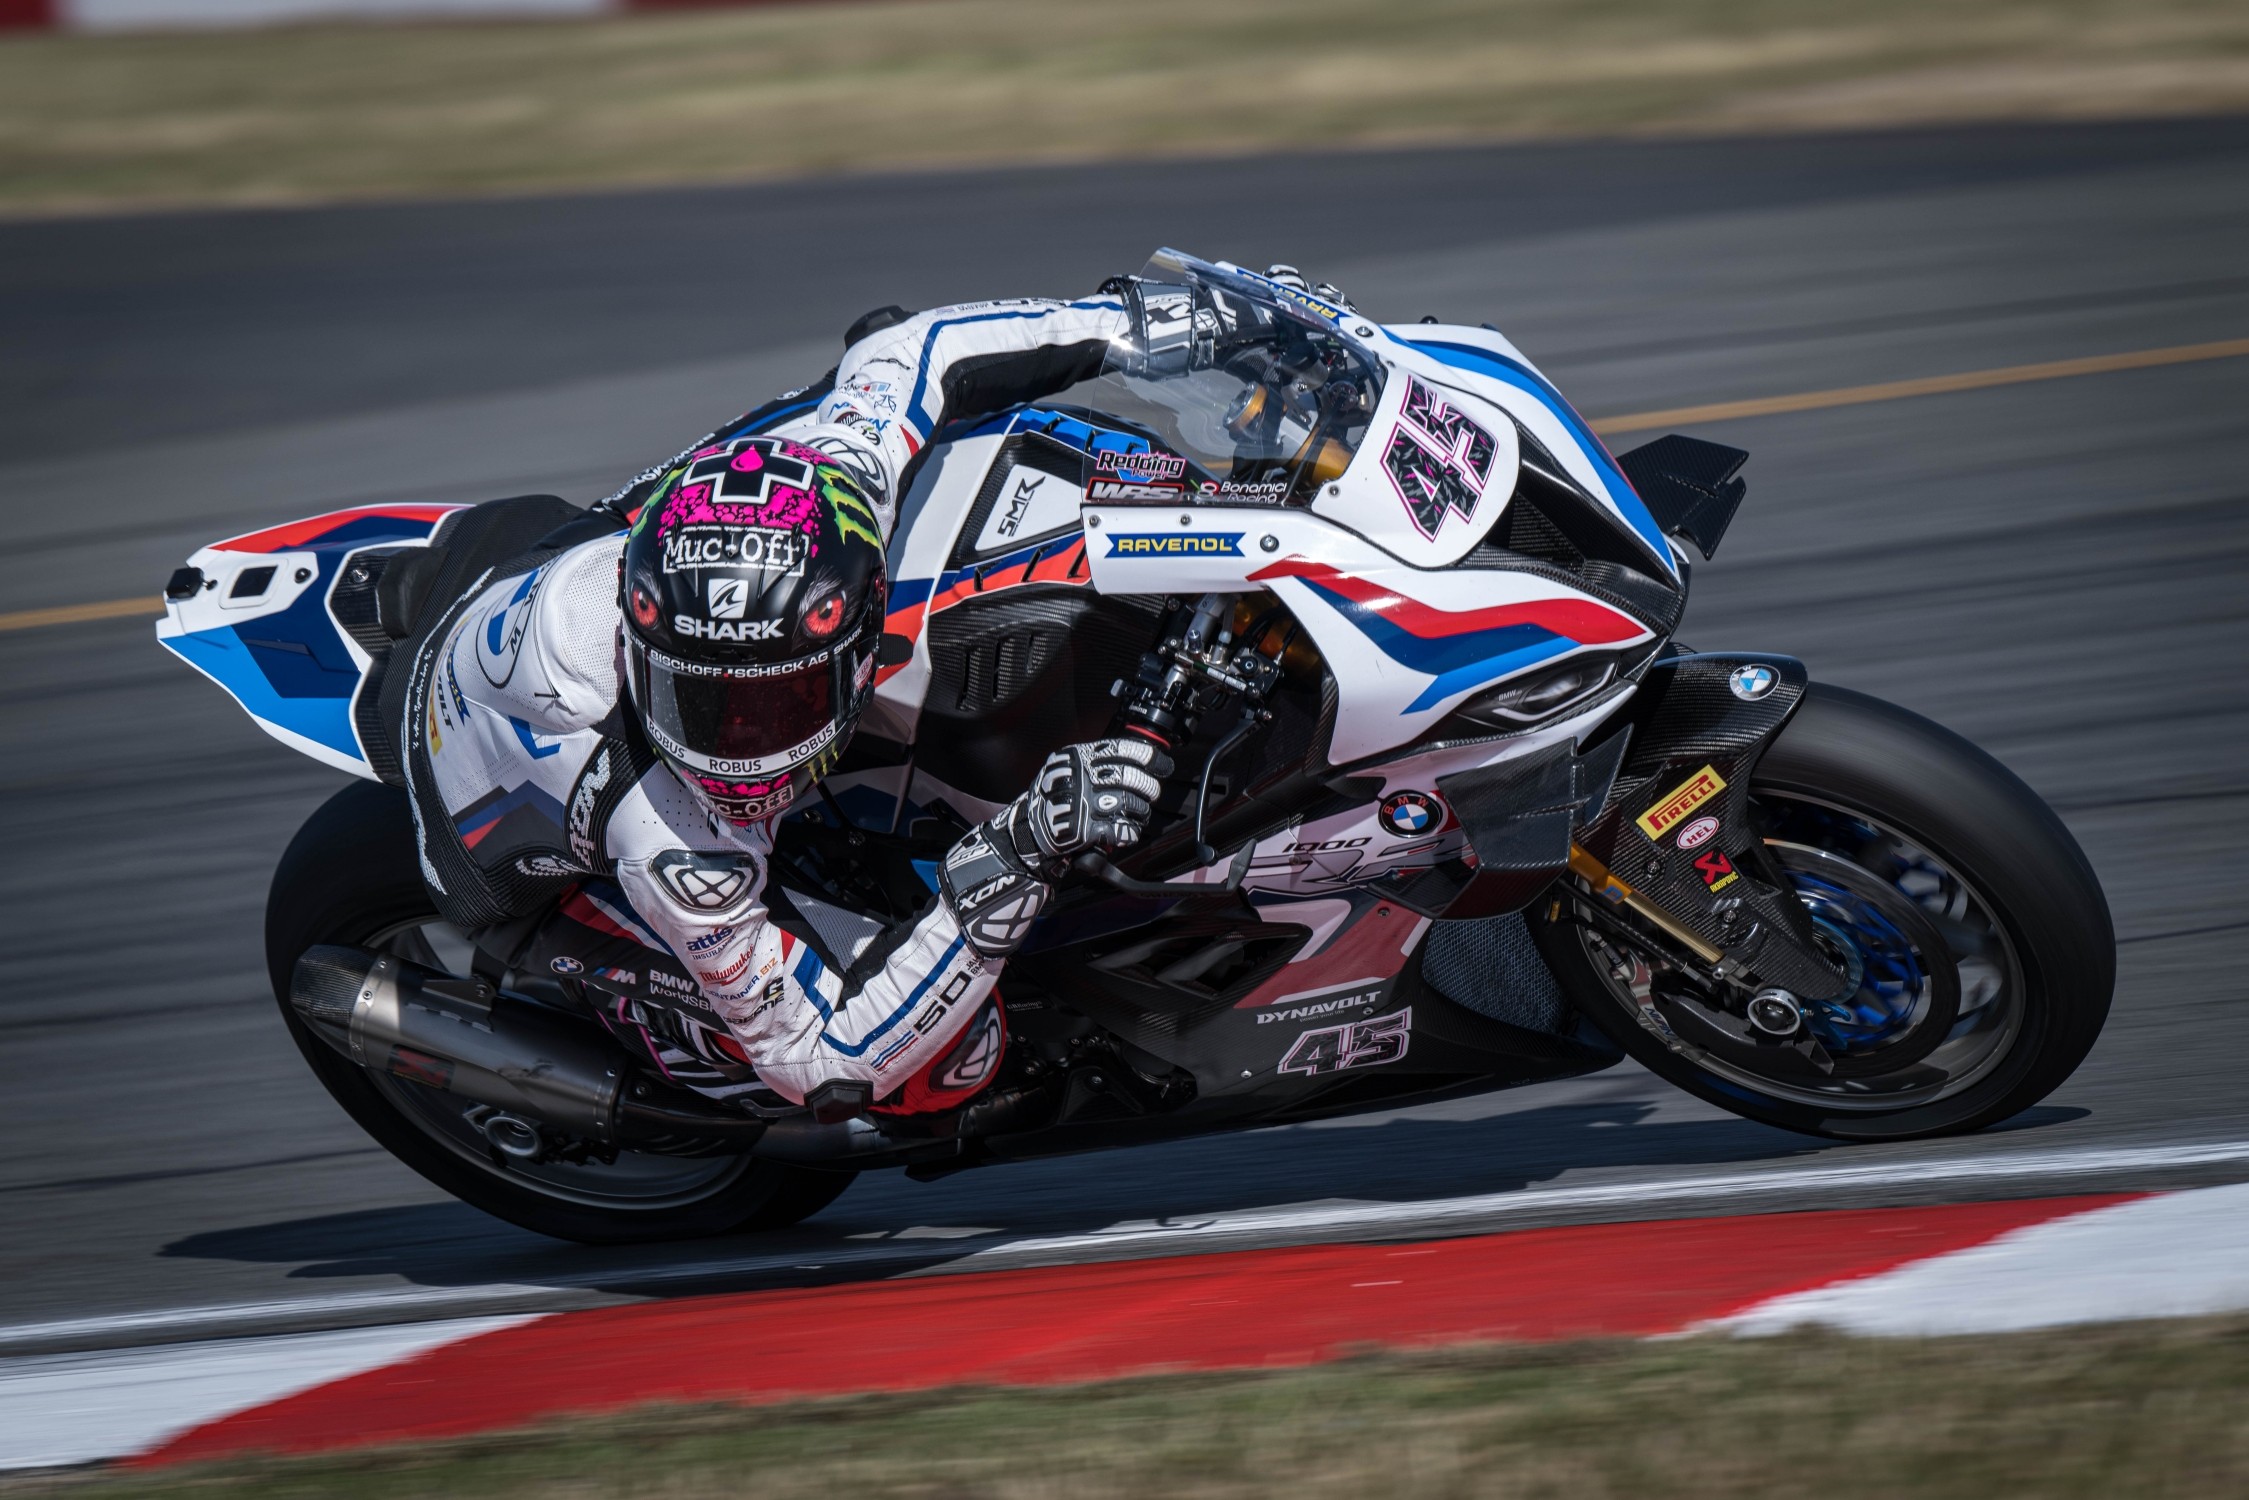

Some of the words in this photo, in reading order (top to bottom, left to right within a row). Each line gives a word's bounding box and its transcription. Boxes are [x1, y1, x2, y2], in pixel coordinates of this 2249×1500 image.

[1097, 449, 1186, 478] Redding
[1380, 375, 1499, 543] 45
[1091, 481, 1181, 501] WRS
[666, 532, 801, 566] Muc-Off
[1117, 537, 1233, 553] RAVENOL
[674, 614, 785, 642] SHARK
[833, 627, 863, 655] SHARK
[734, 660, 804, 679] SCHECK
[807, 651, 829, 667] AG
[648, 722, 687, 760] ROBUS
[788, 725, 834, 762] ROBUS
[709, 758, 762, 774] ROBUS
[1646, 773, 1717, 832] PIRELLI
[1281, 836, 1373, 853] 1000
[1685, 824, 1713, 845] HEL
[686, 926, 734, 952] attis
[650, 969, 695, 993] BMW
[1256, 990, 1383, 1025] DYNAVOLT
[1276, 1005, 1413, 1077] 45
